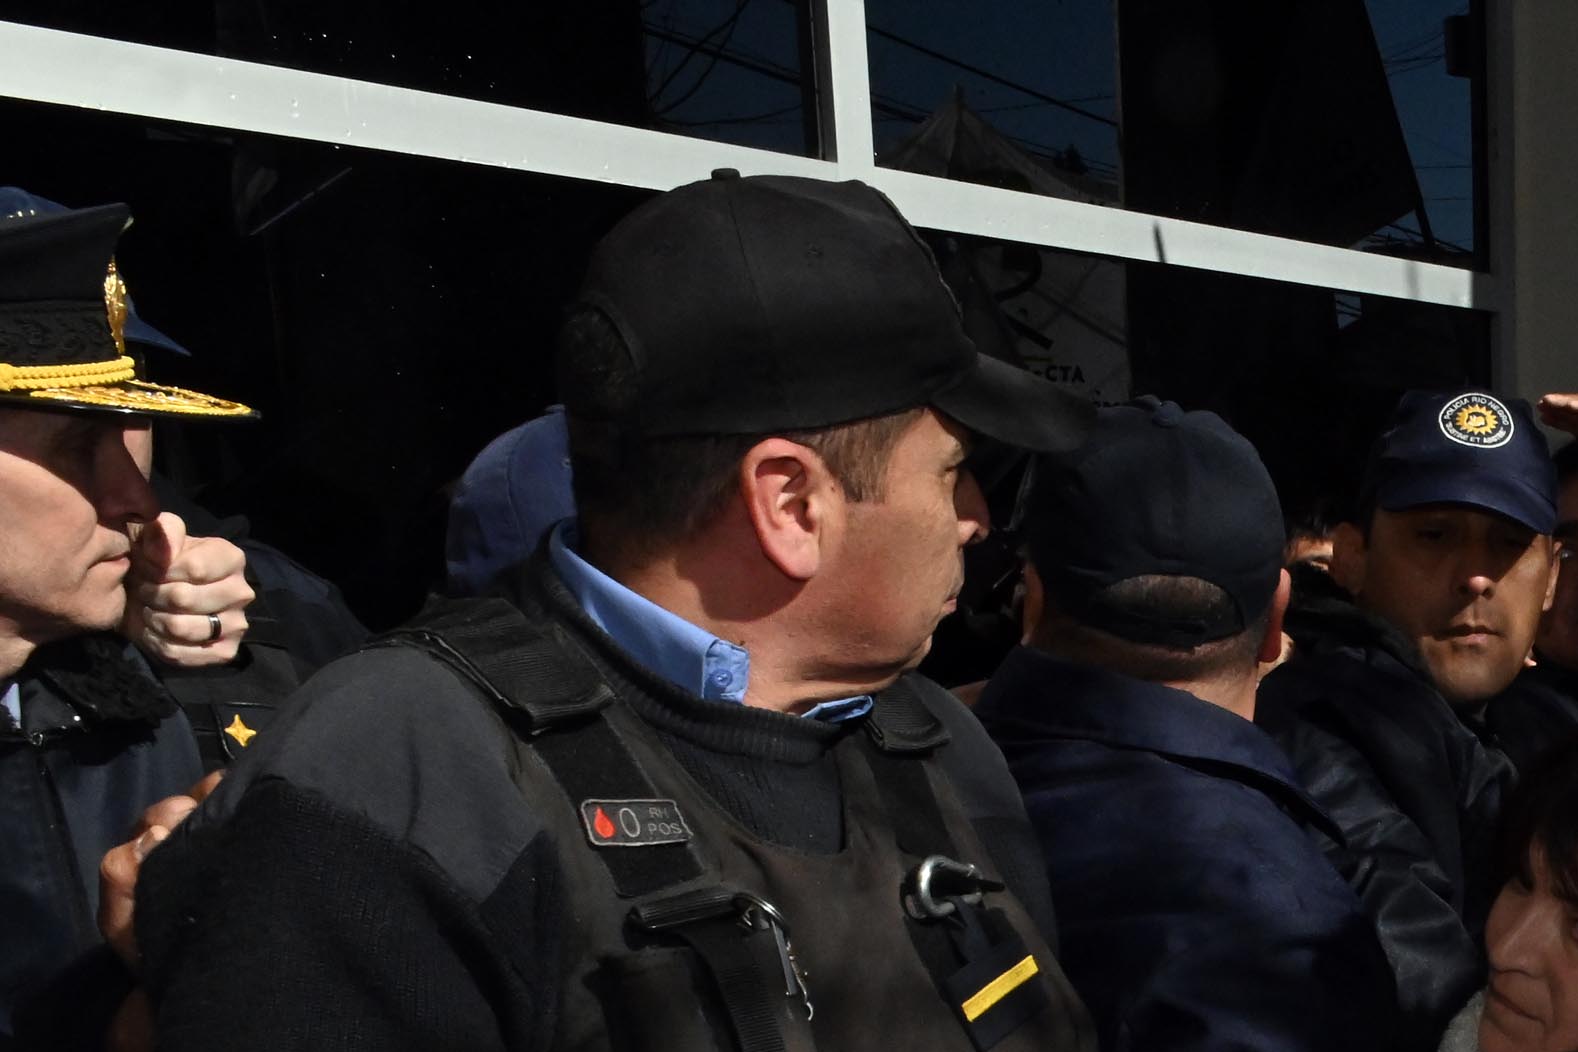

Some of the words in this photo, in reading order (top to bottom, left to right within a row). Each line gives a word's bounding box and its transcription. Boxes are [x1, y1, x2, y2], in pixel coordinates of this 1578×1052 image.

[1471, 396, 1487, 405] RIO
[648, 806, 668, 819] RH
[648, 822, 682, 836] POS
